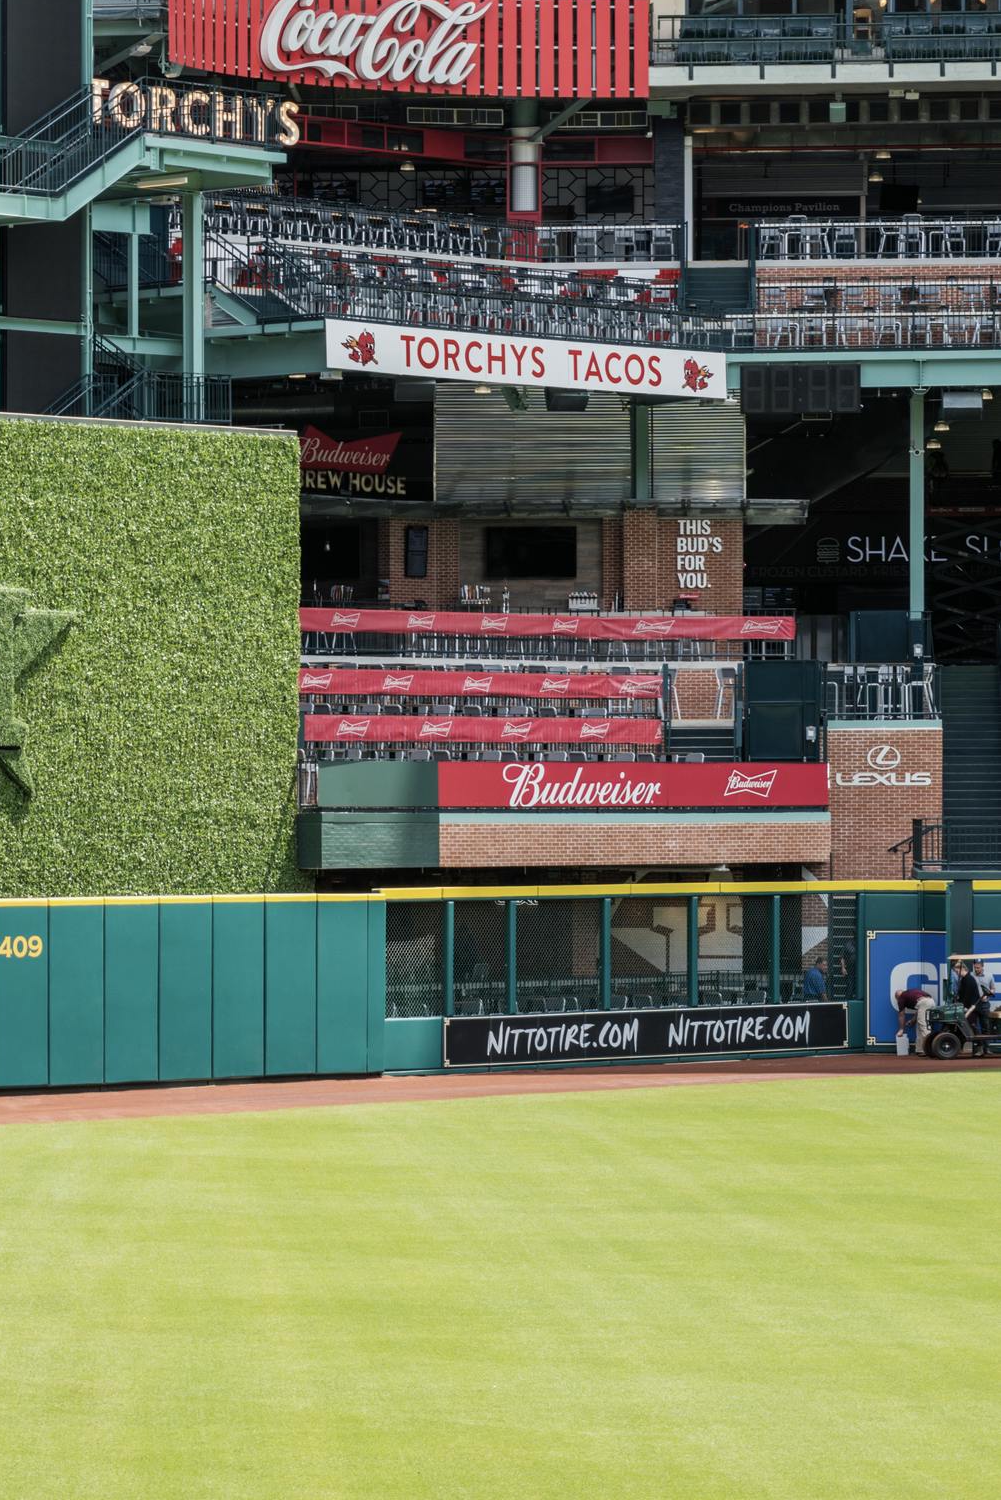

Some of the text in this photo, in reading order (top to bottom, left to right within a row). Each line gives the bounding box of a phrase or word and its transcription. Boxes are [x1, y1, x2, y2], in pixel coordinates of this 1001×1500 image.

[729, 202, 840, 214] Champions Pavilion
[400, 335, 663, 387] TORCHYS TACOS
[299, 437, 390, 466] Budweiser
[349, 473, 406, 495] HOUSE
[678, 520, 711, 535] THIS
[677, 537, 722, 553] BUD'S
[677, 555, 705, 570] FOR
[677, 572, 712, 588] YOU.
[502, 763, 661, 808] Budweiser
[731, 775, 774, 790] Budweiser
[835, 772, 932, 786] LEXUS
[487, 1010, 810, 1056] NITTOTIRE.COM NITTOTIRE.COM
